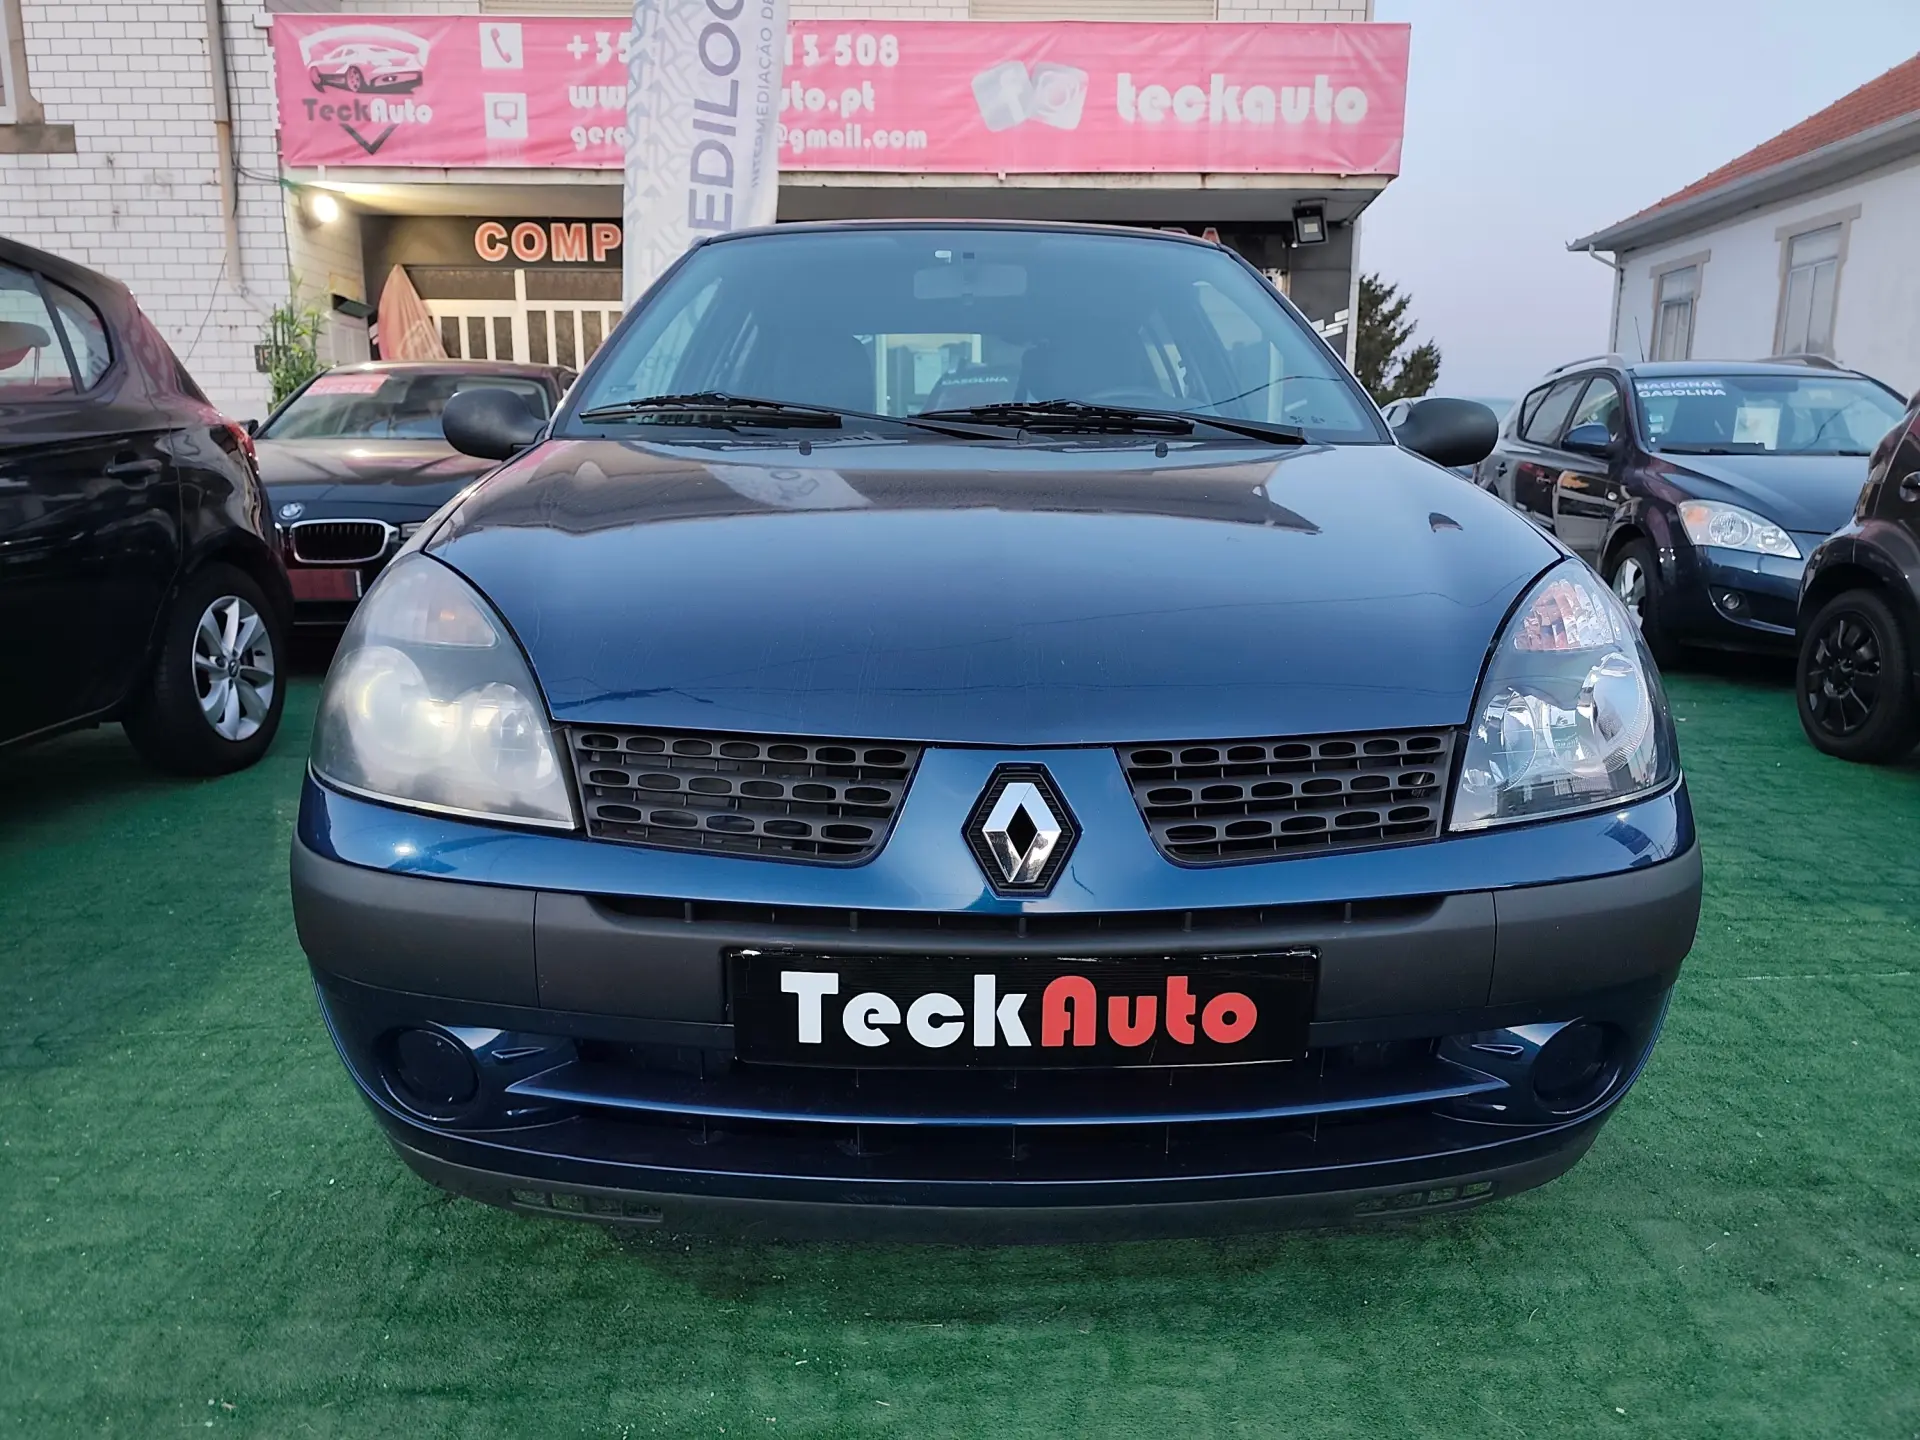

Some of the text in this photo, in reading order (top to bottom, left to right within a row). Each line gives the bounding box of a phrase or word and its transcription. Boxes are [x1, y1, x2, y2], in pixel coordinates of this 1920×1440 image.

[834, 33, 900, 67] 508
[301, 97, 434, 124] TeckAuto
[1116, 73, 1369, 125] teckauto
[474, 221, 622, 263] COMP
[1635, 380, 1723, 389] NACIONAL
[1637, 388, 1727, 398] GASOLINA
[780, 970, 1258, 1049] TeckAuto
